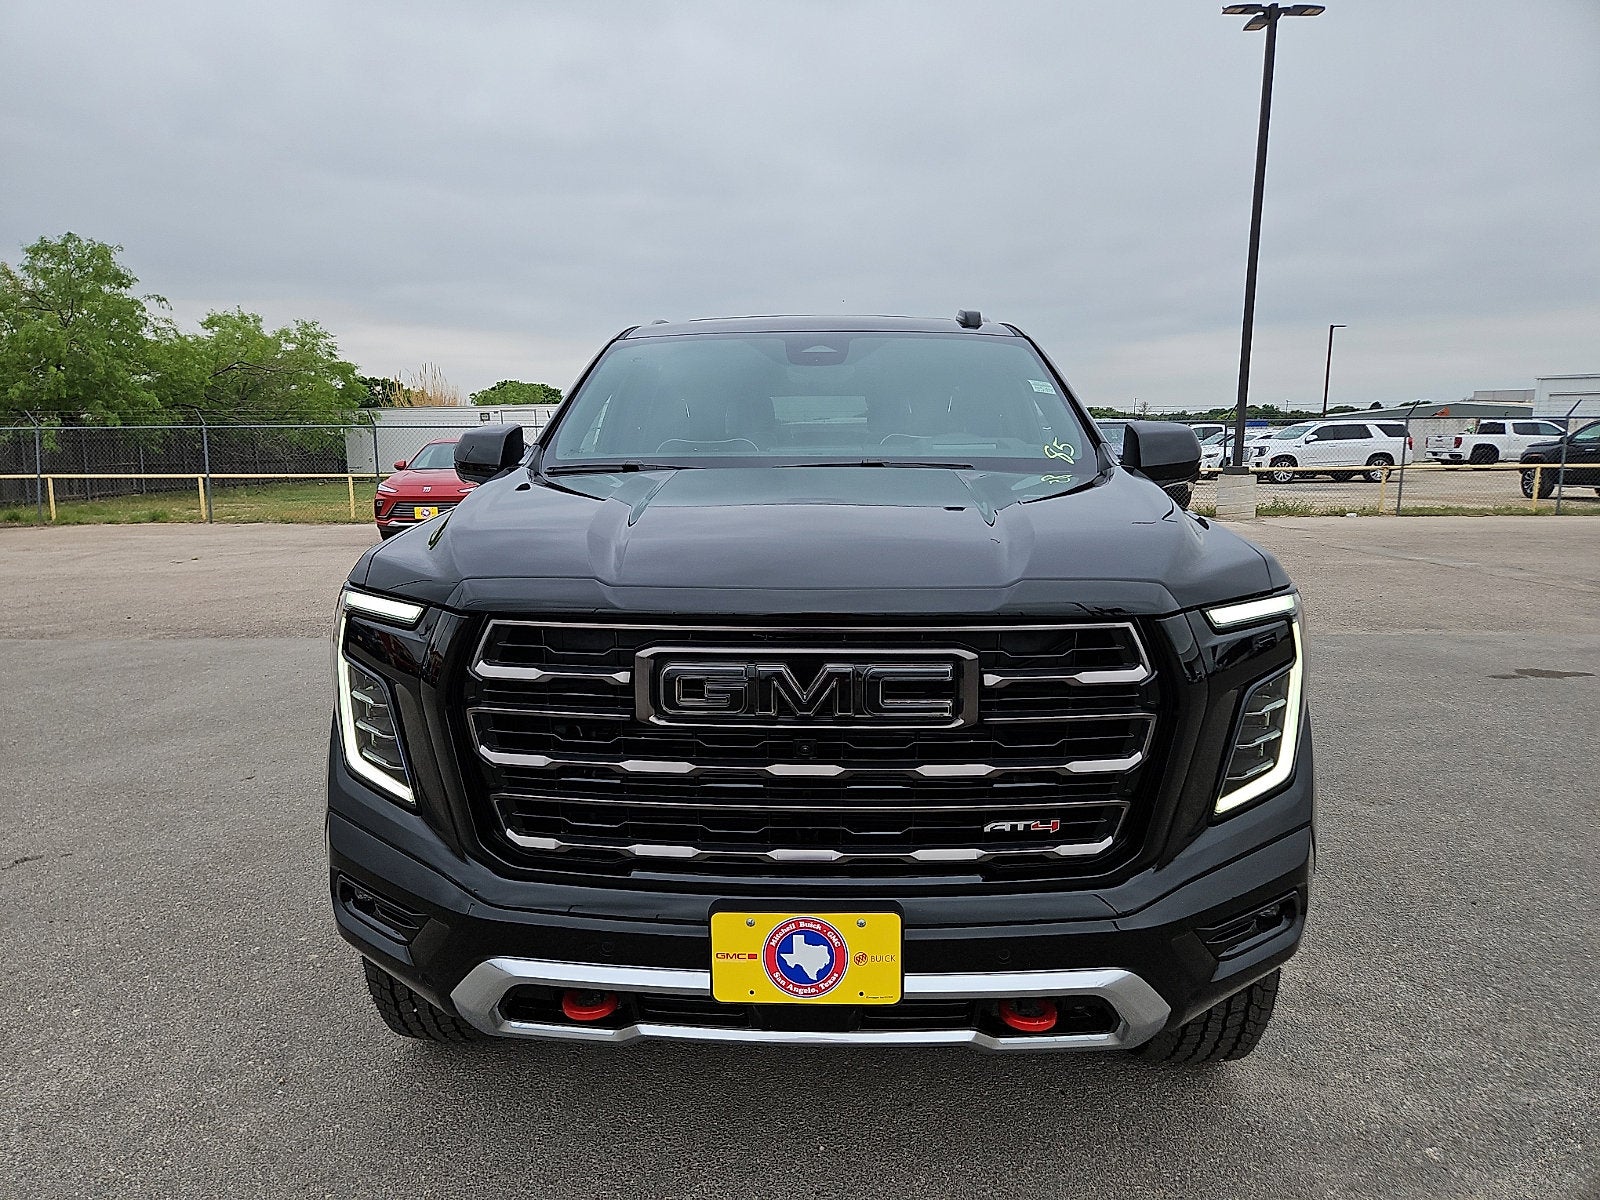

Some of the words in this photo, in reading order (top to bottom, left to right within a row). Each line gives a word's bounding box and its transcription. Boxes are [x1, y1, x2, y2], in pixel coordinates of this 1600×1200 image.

[660, 662, 953, 717] GMC
[983, 819, 1061, 834] AT4
[769, 922, 796, 947] Mitchell
[799, 921, 822, 931] Buick
[827, 931, 841, 948] GMC
[715, 952, 747, 960] GMC
[870, 954, 896, 963] BUICK
[773, 971, 787, 987] San
[786, 983, 819, 995] Angelo,
[818, 972, 839, 991] Texas
